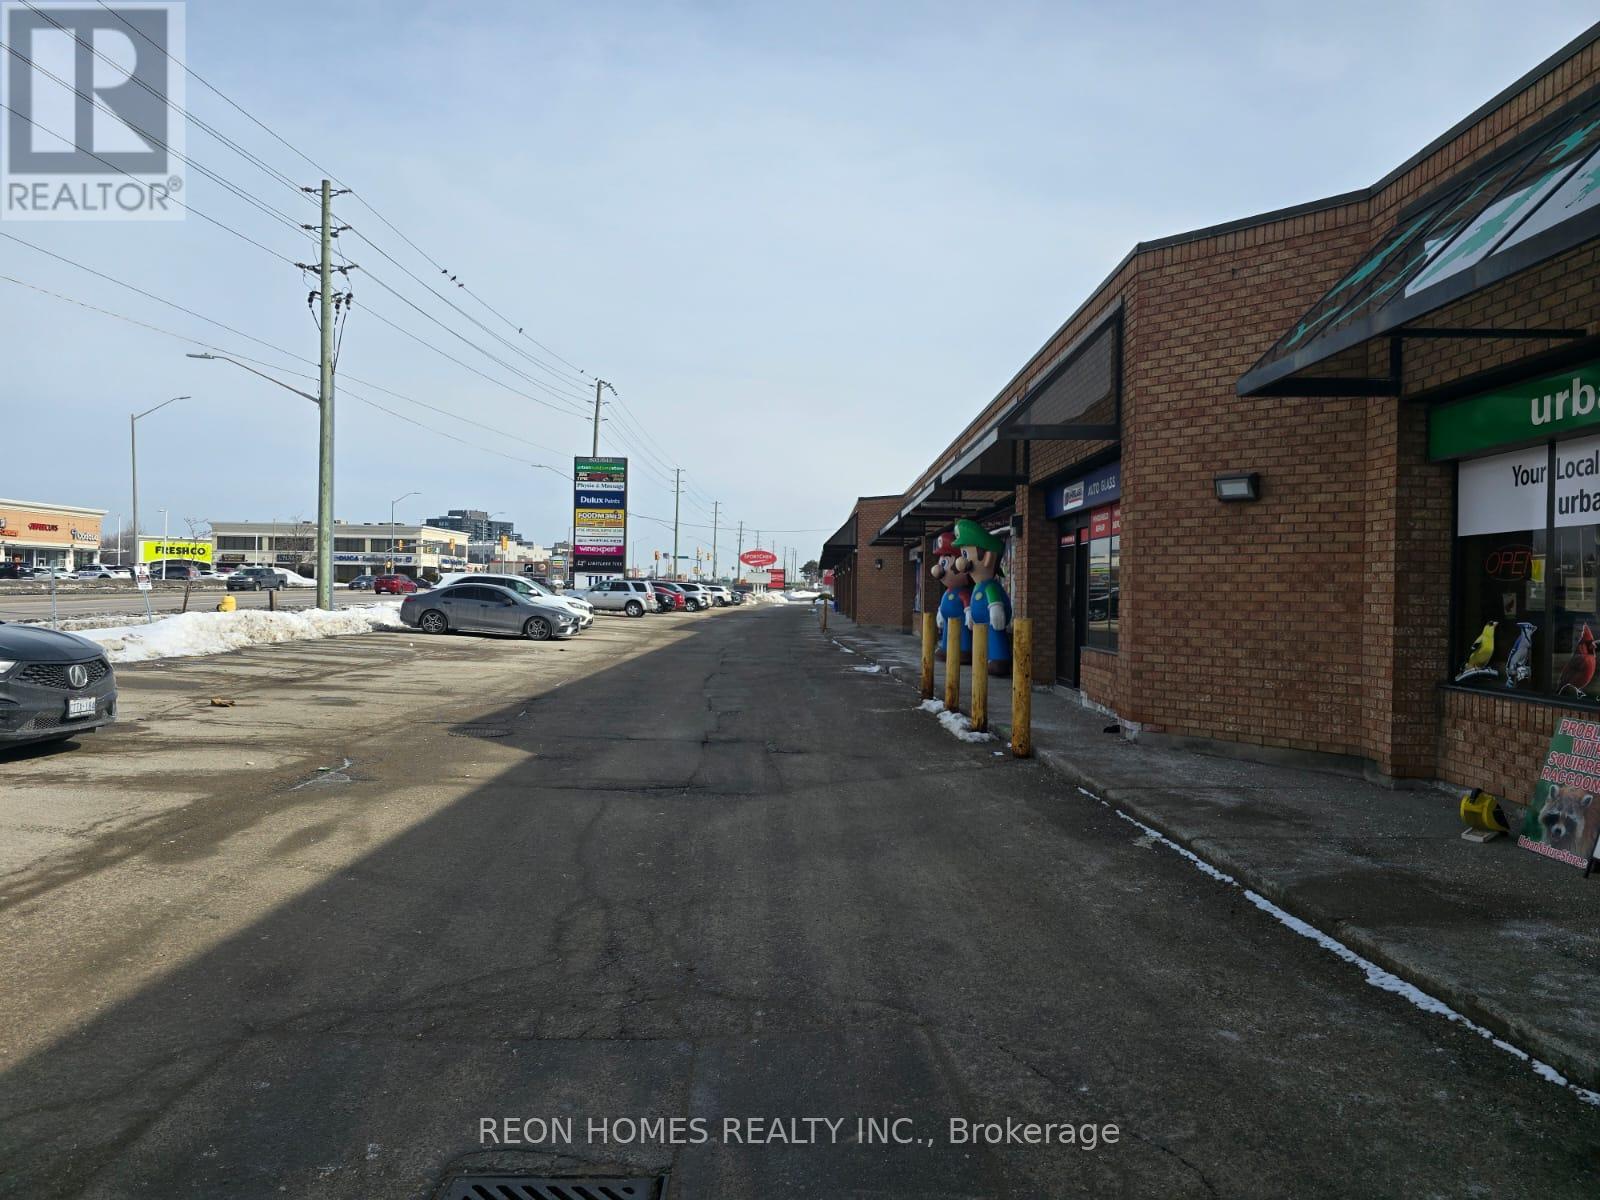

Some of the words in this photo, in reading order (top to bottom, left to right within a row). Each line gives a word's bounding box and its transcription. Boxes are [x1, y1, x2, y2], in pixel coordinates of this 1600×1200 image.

[1531, 377, 1600, 426] urb
[1512, 464, 1546, 487] Your
[1557, 449, 1599, 480] Local
[1088, 481, 1100, 497] AUTO
[1100, 475, 1116, 492] GLASS
[580, 496, 603, 504] Dulux
[1559, 488, 1600, 515] urba
[155, 546, 206, 556] FRESHCO
